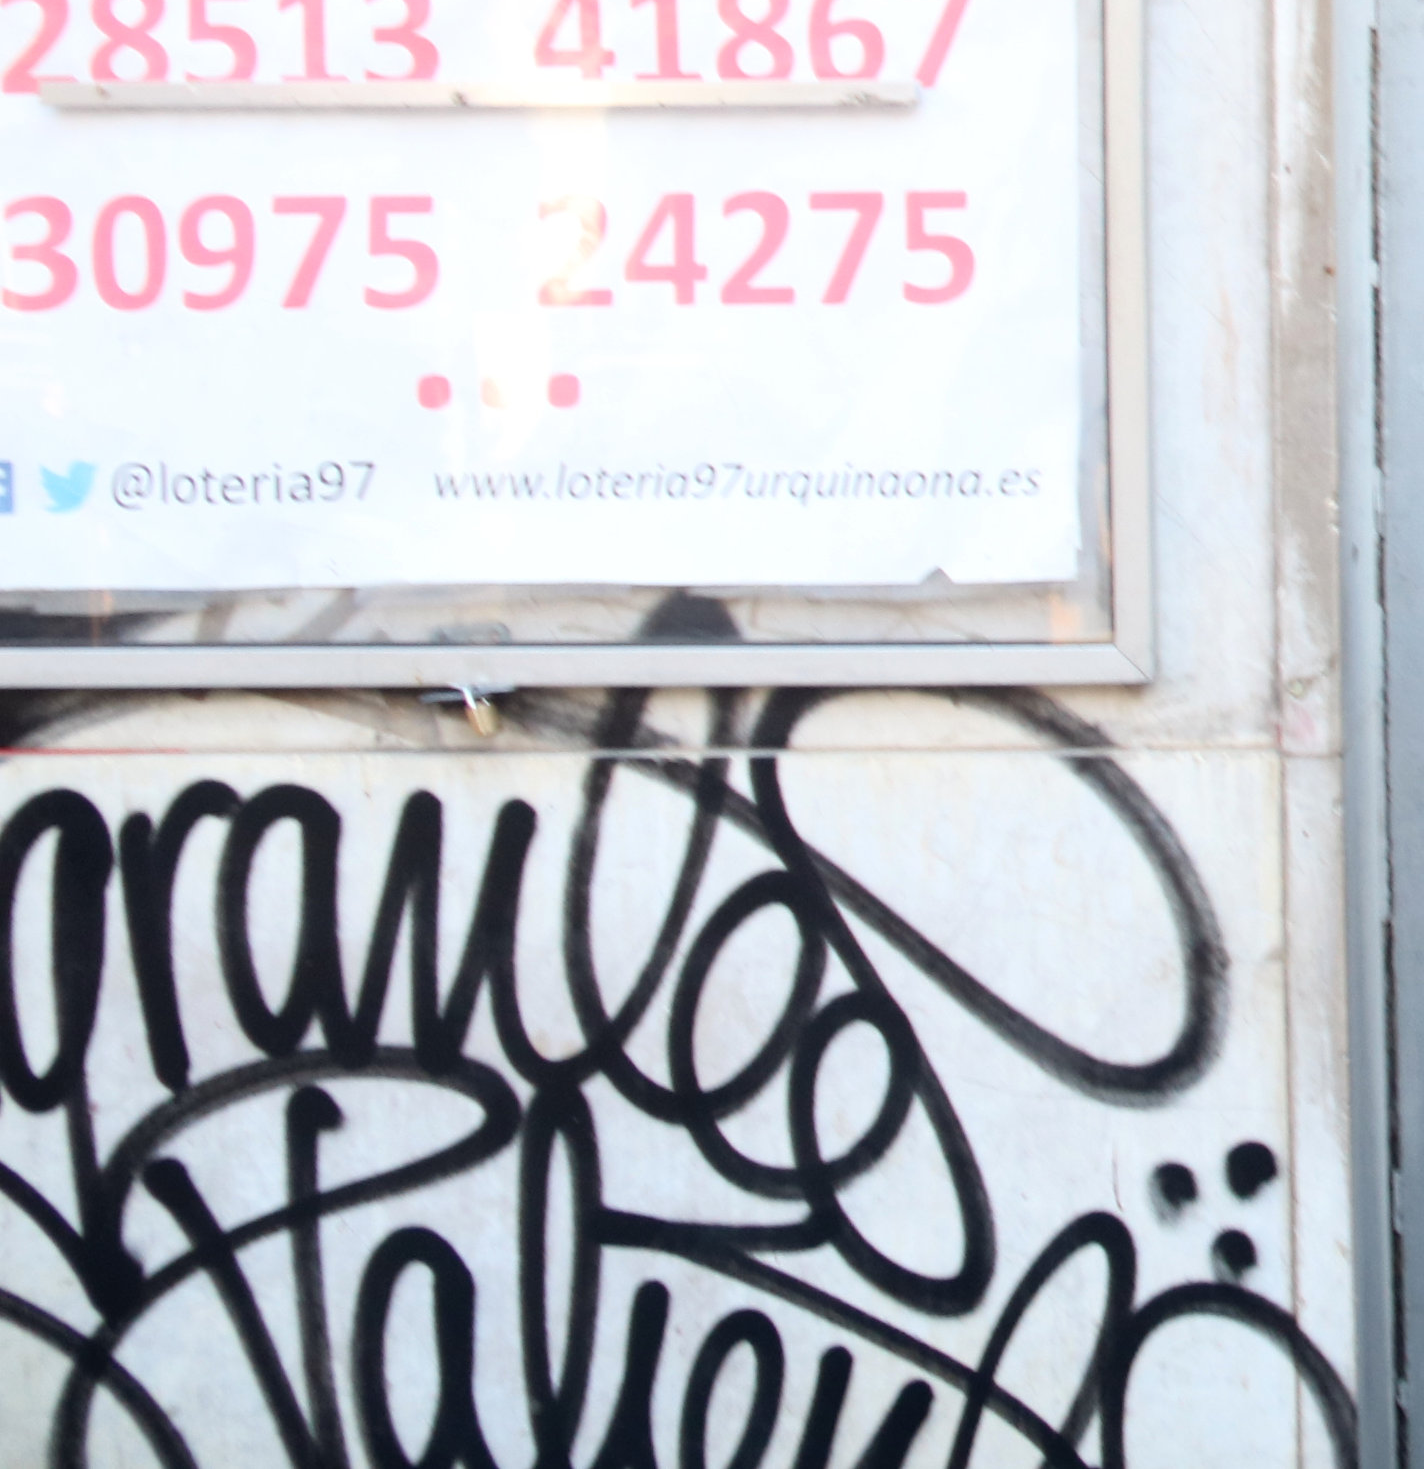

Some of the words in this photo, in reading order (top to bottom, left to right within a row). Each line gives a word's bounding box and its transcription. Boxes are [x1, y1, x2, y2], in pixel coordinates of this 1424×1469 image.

[1, 193, 441, 312] 30975
[536, 189, 978, 308] 24275
[111, 460, 378, 510] @loteria97
[433, 463, 1042, 507] www.loteria97urquinaona.es
